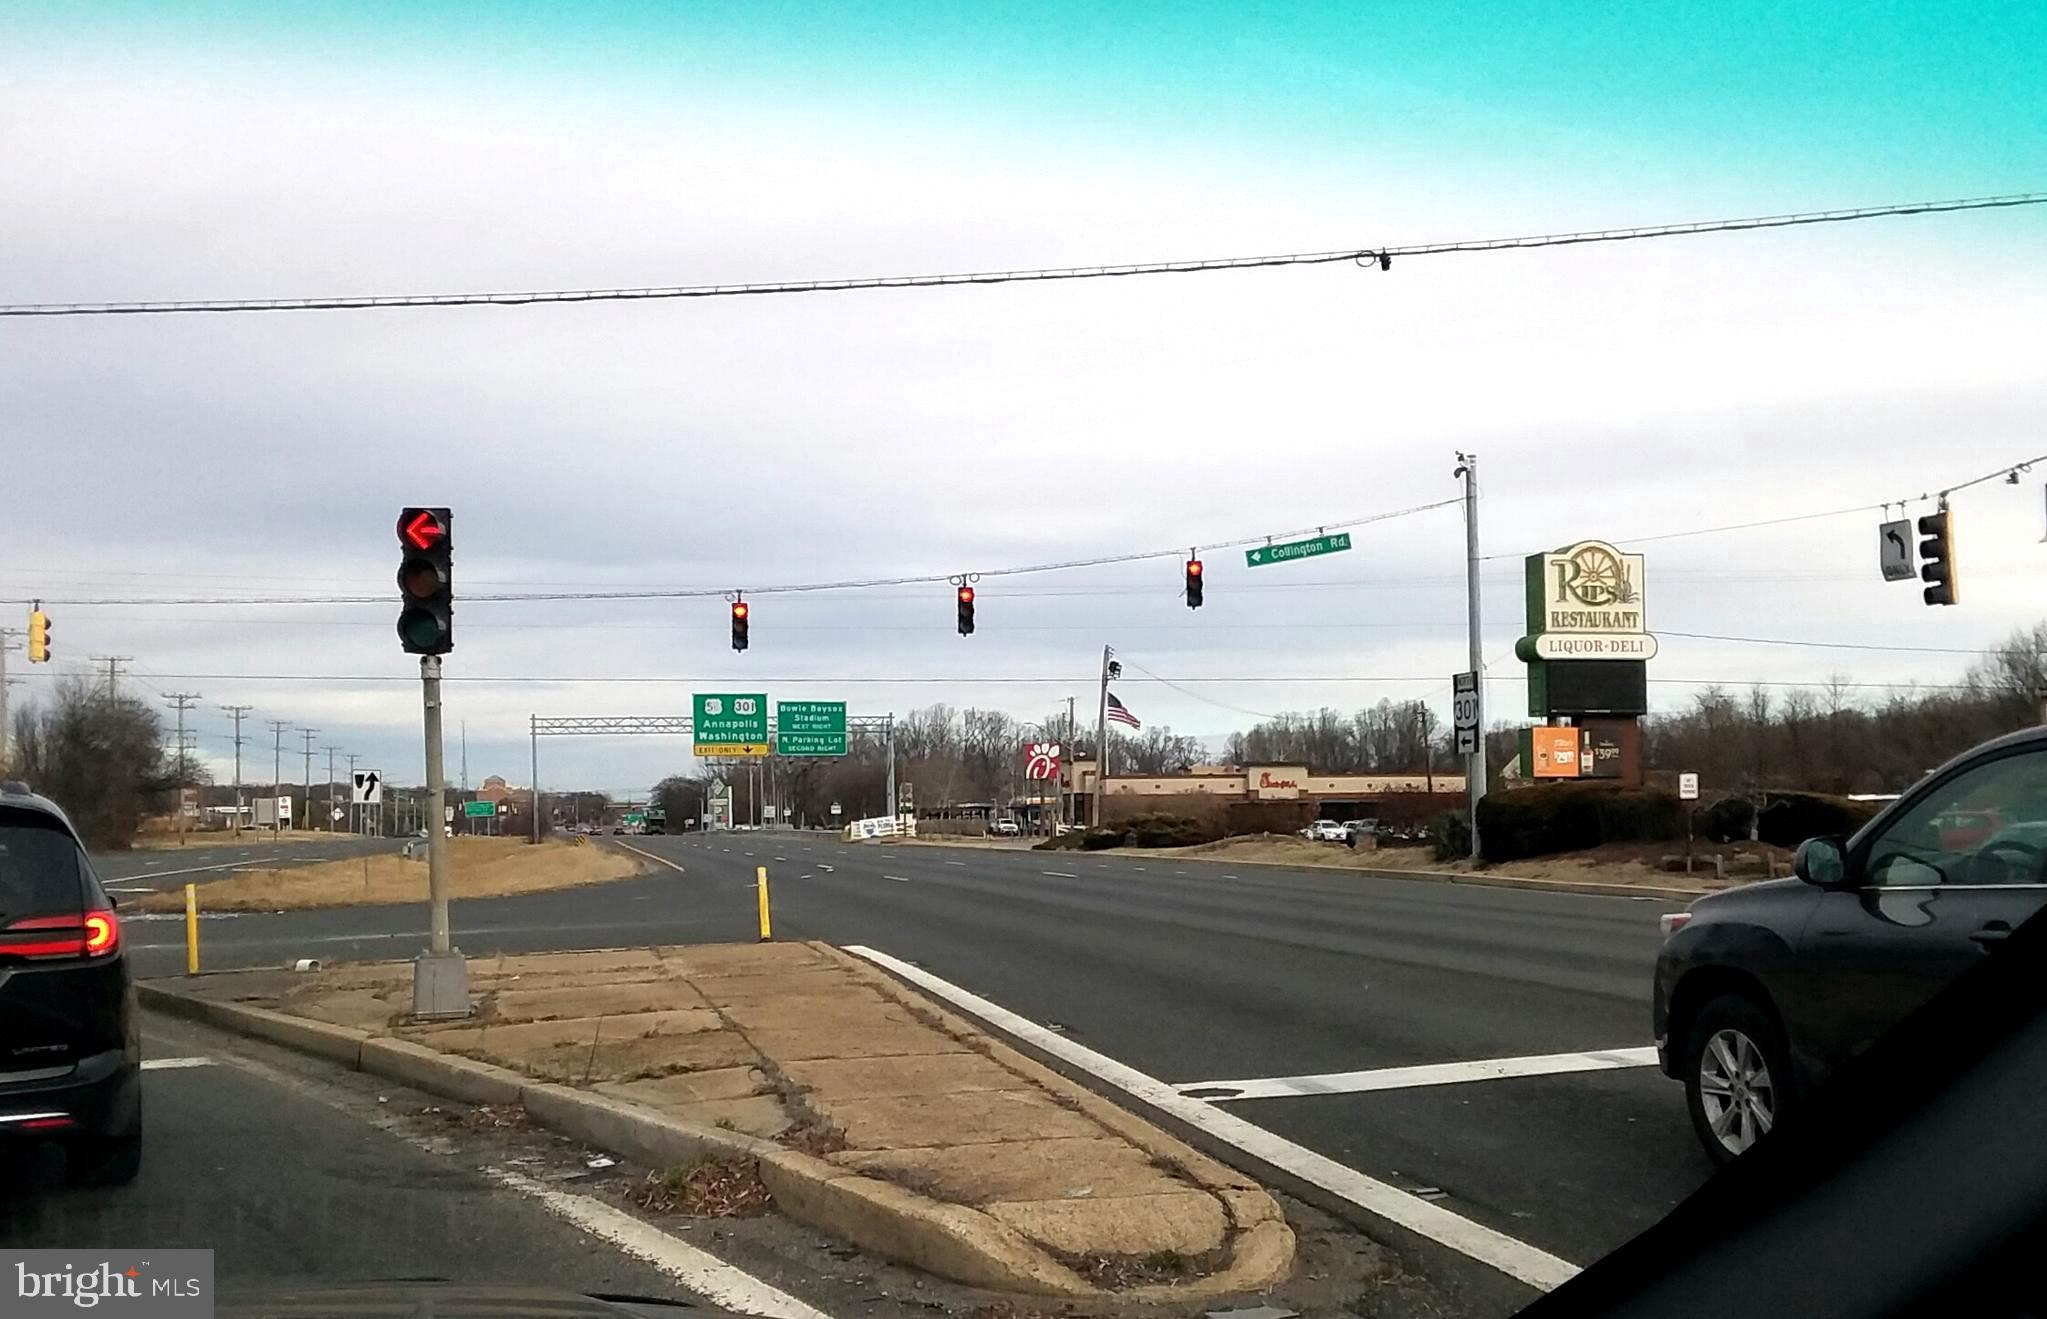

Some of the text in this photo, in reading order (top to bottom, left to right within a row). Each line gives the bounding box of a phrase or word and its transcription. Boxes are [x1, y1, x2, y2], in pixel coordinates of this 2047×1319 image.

[1271, 537, 1345, 559] Collington Rd
[1551, 611, 1639, 628] RESTAURANT
[735, 701, 754, 712] 301
[810, 705, 843, 713] Baysox
[1456, 699, 1477, 720] 301
[703, 720, 758, 729] Annapolis
[699, 732, 763, 742] Washington
[792, 736, 825, 744] Parking
